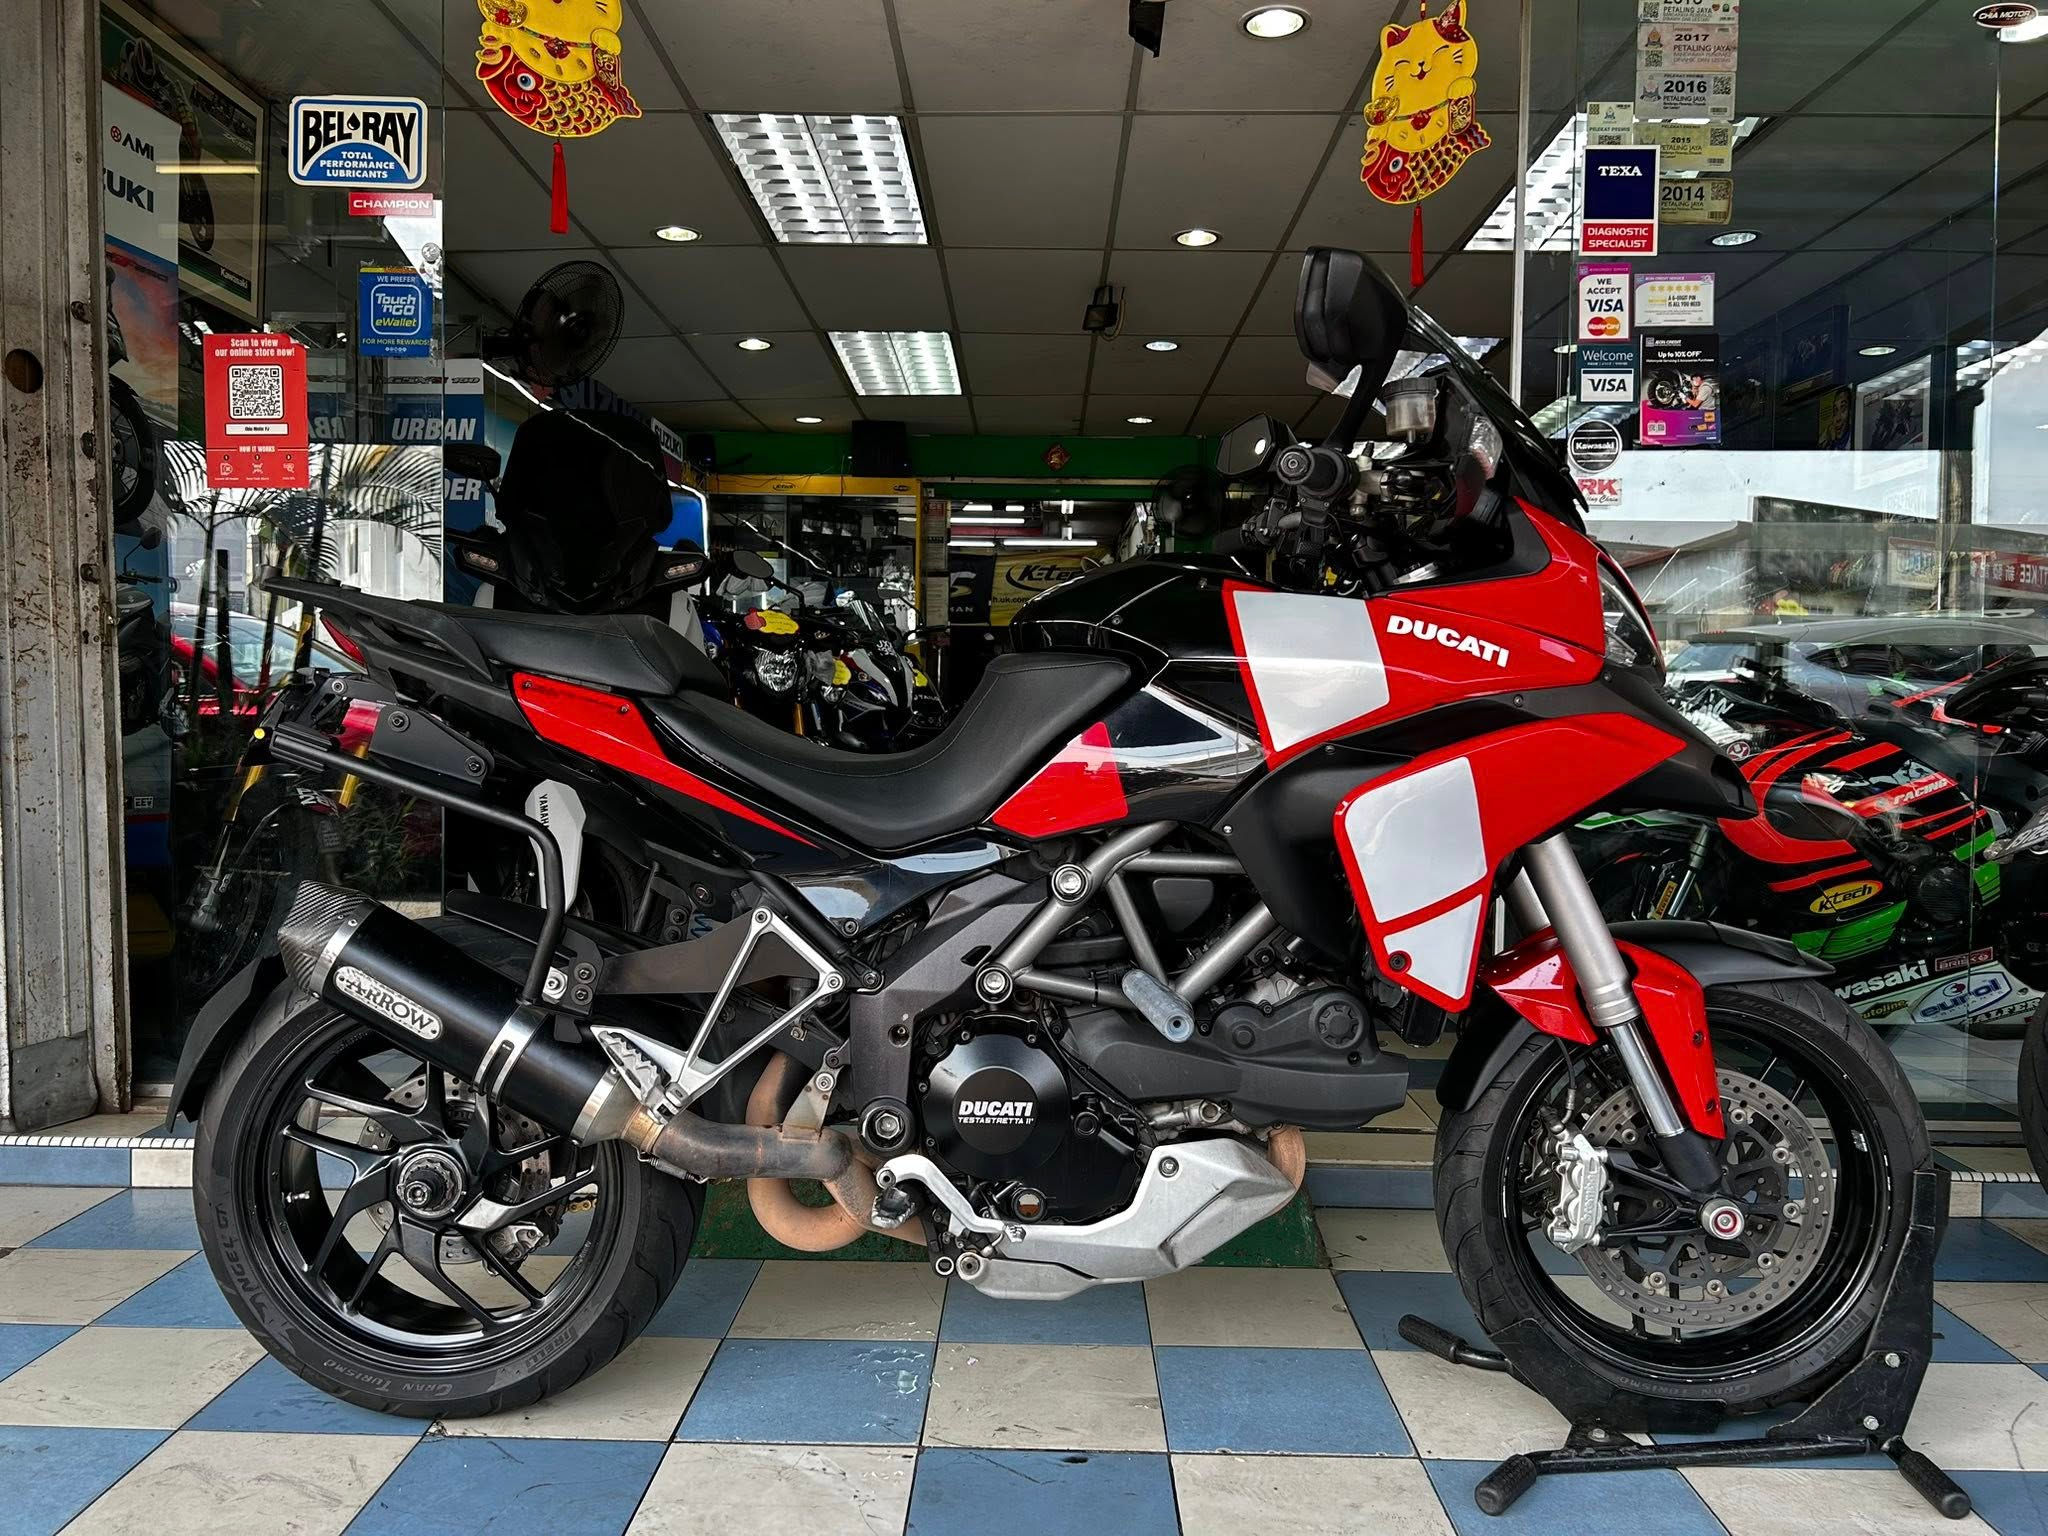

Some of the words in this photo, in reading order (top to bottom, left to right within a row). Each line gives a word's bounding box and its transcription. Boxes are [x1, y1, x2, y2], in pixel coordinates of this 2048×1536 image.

[1663, 80, 1707, 93] 2016
[341, 151, 373, 160] TOTAL
[320, 160, 395, 170] PERFORMANCE
[326, 169, 388, 178] LUBRICANTS
[1598, 166, 1643, 176] TEXA
[104, 167, 154, 213] UKI
[1662, 186, 1705, 200] 2014
[353, 200, 429, 209] CHAMPION
[1587, 228, 1648, 236] DIAGNOSTIC
[1588, 240, 1648, 248] SPECIALIST
[390, 276, 416, 284] PREFER
[376, 293, 416, 305] Touch
[1585, 299, 1624, 312] VISA
[376, 317, 416, 327] eWallet
[230, 338, 250, 348] Scan
[250, 338, 260, 348] to
[260, 338, 279, 348] view
[214, 349, 229, 358] our
[230, 348, 254, 358] online
[254, 348, 276, 358] store
[1582, 350, 1634, 361] Welcome
[1587, 378, 1627, 392] VISA
[391, 418, 477, 441] URBAN
[1576, 442, 1615, 450] Kawasaki
[1578, 478, 1618, 495] RK
[1386, 614, 1510, 668] DUCATI
[1920, 978, 2000, 1018] eurol
[345, 978, 434, 1031] ARROW
[958, 1100, 1033, 1116] DUCATI
[958, 1116, 1024, 1124] TESTASTRETTA
[322, 1358, 394, 1392] TURISMO
[400, 1382, 454, 1397] GRAN
